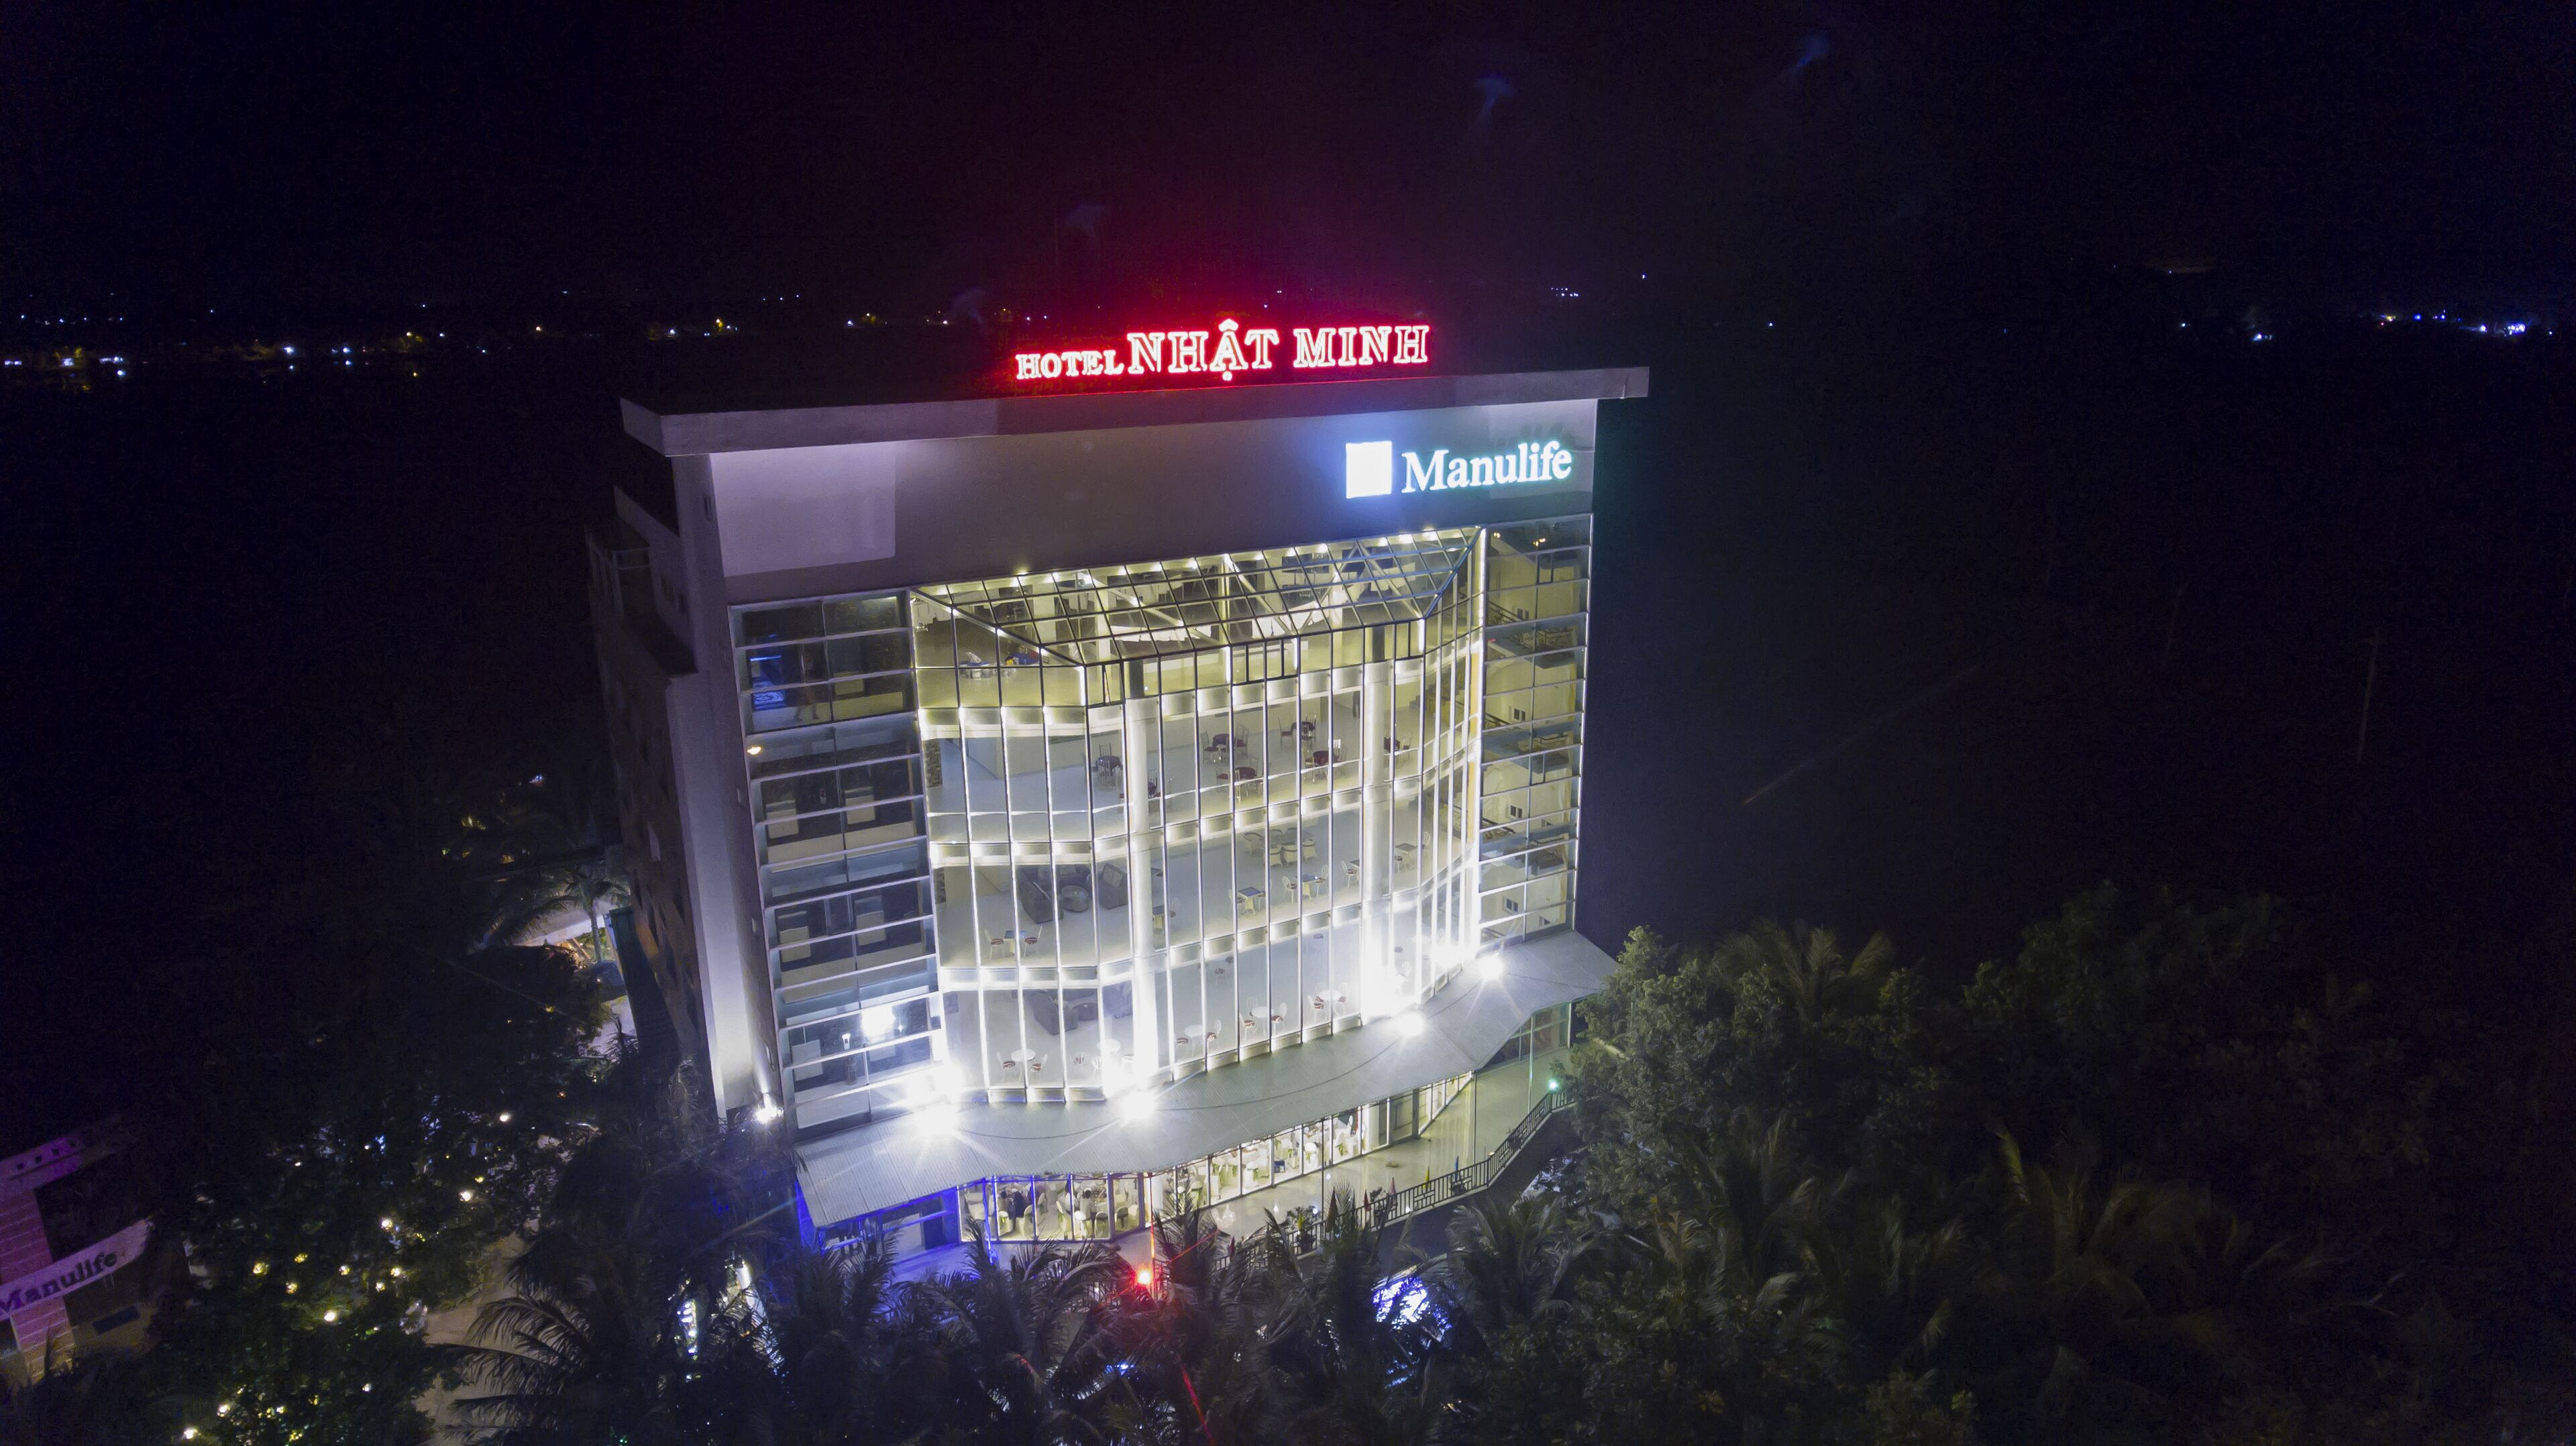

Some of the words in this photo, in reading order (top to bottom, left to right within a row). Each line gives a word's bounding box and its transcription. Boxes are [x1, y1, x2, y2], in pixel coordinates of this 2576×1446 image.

[1016, 351, 1123, 379] HOTEL
[1127, 319, 1279, 381] NHẬT
[1293, 326, 1429, 367] MINH
[1401, 441, 1572, 493] Manulife
